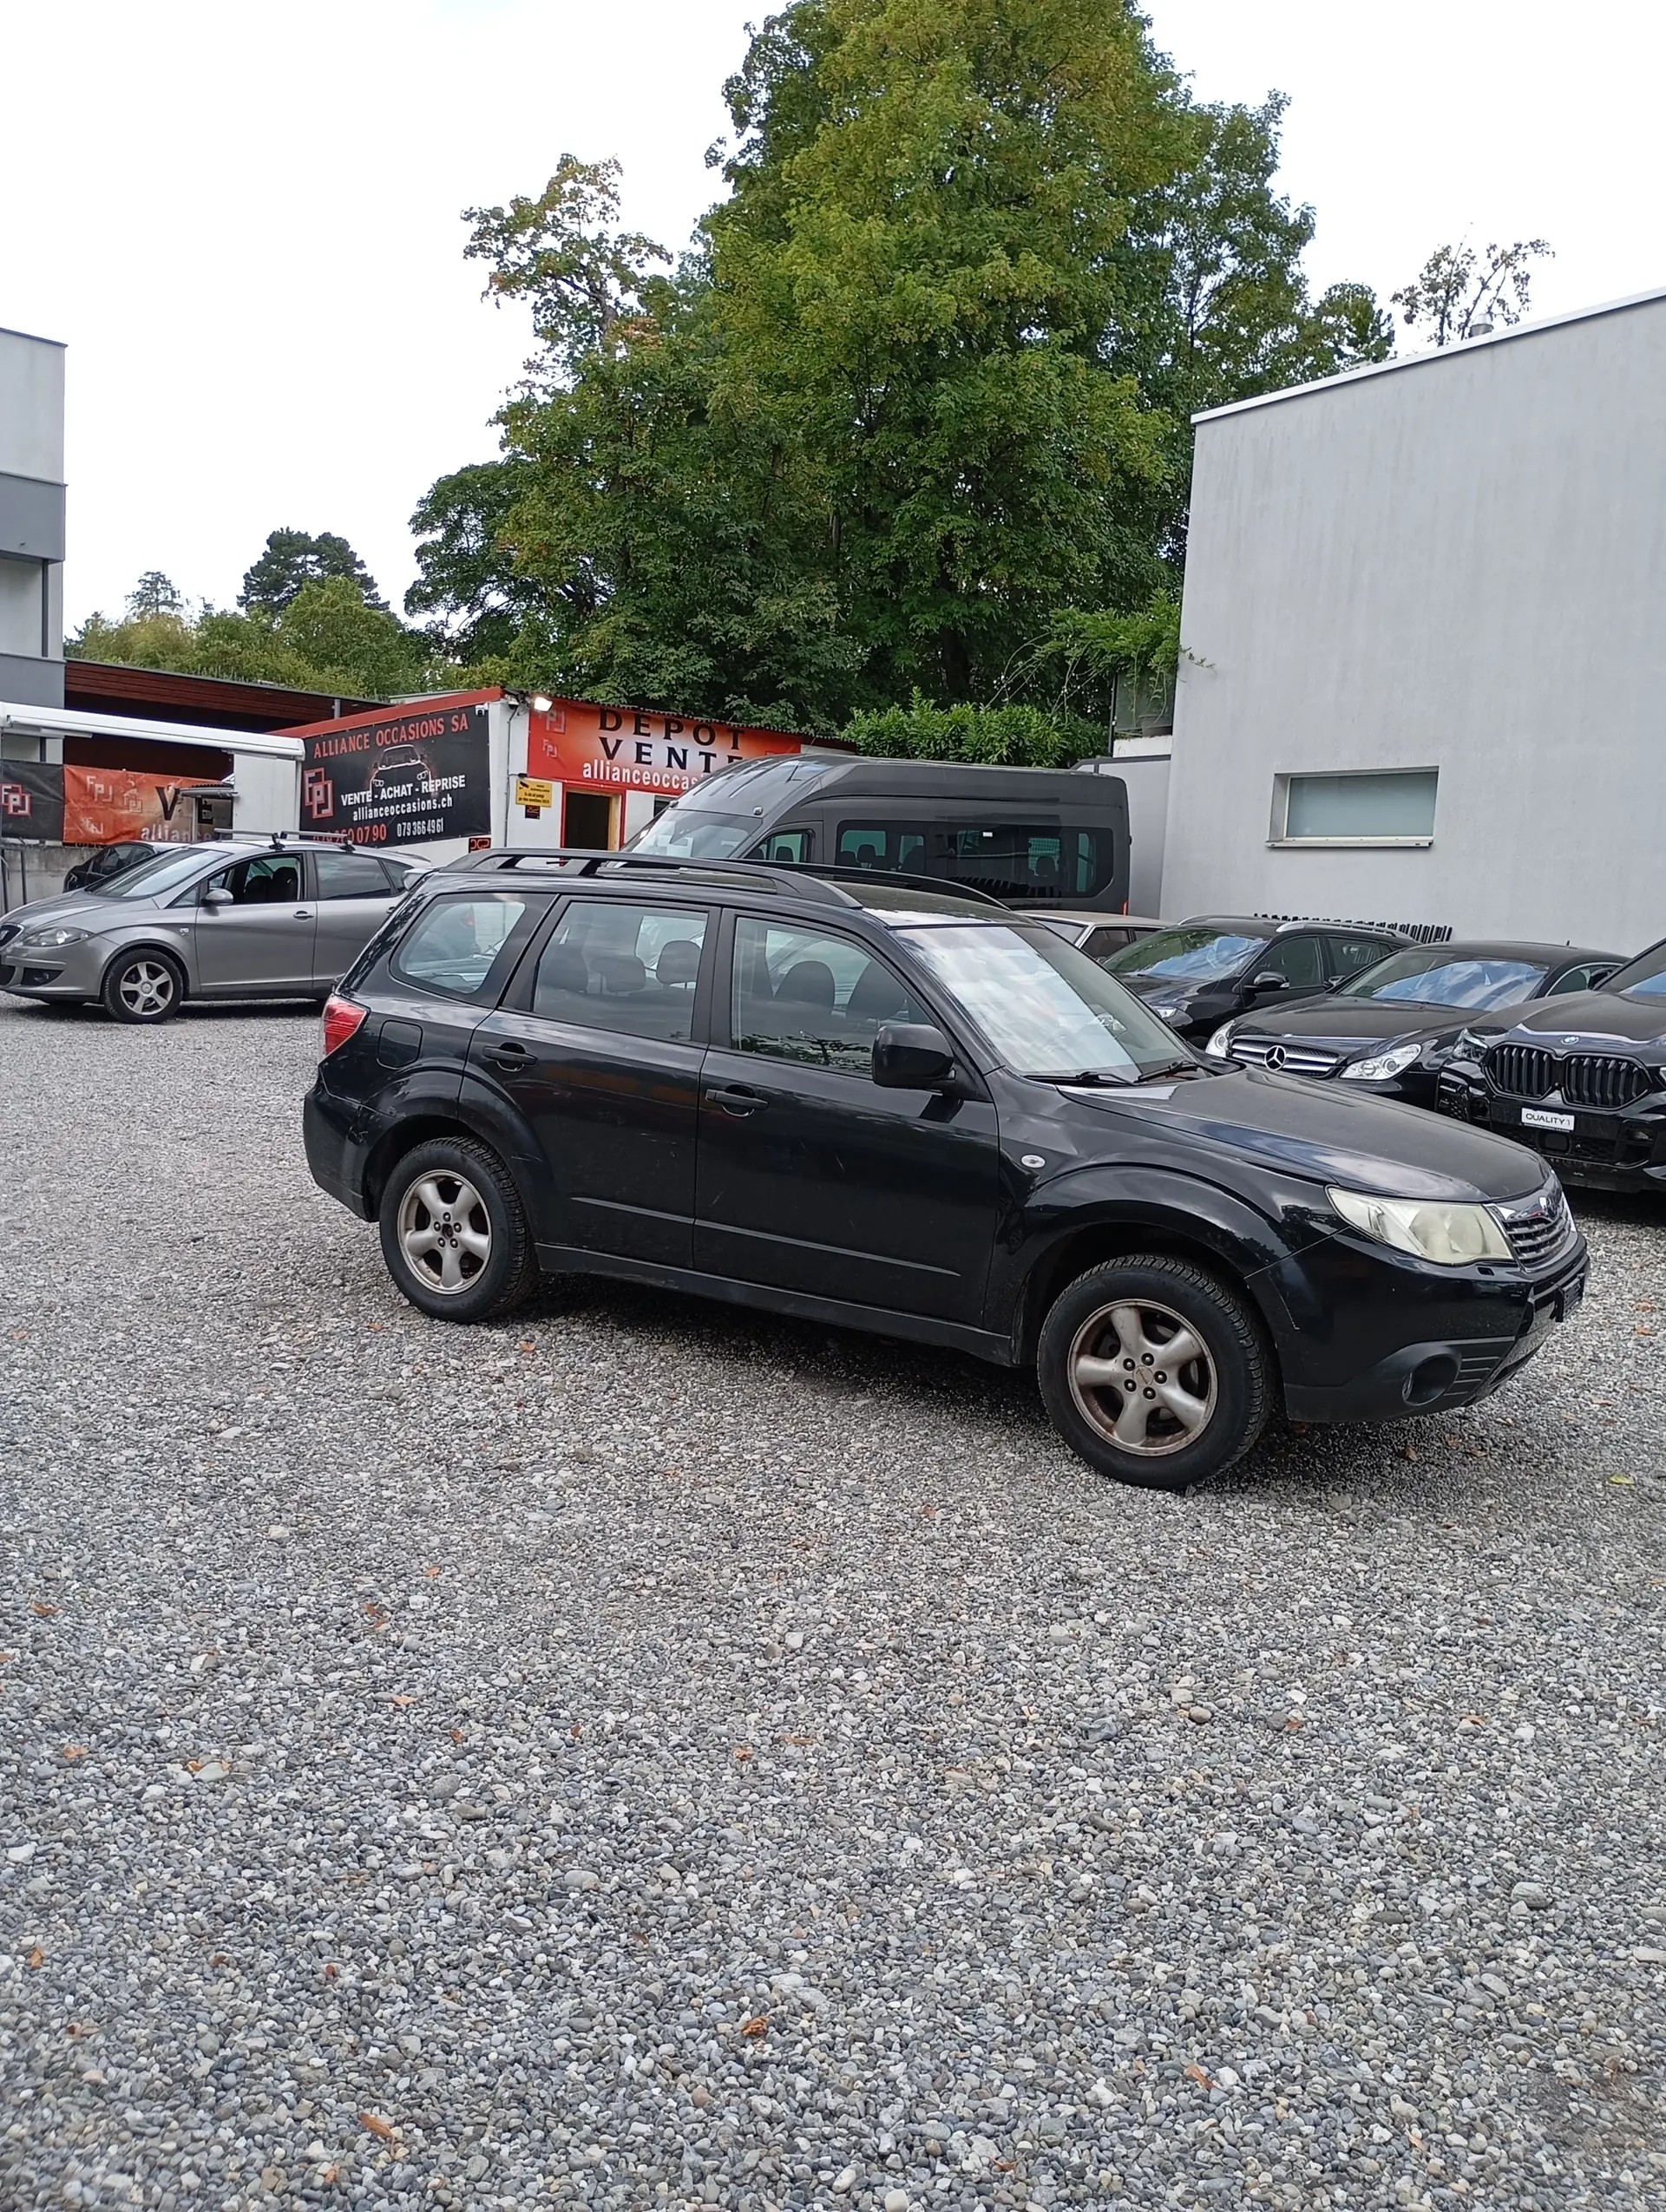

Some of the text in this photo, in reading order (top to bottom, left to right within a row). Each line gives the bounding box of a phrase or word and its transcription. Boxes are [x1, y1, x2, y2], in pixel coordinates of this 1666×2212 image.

[313, 712, 469, 759] ALLIANCE OCCASIONS SA
[598, 708, 744, 750] DEPOT
[341, 789, 372, 807] VENTE
[380, 783, 414, 801] ACHAT
[421, 775, 466, 795] REPRISE
[582, 759, 704, 791] allianceoccas
[352, 794, 453, 821] allianceoccasions.ch
